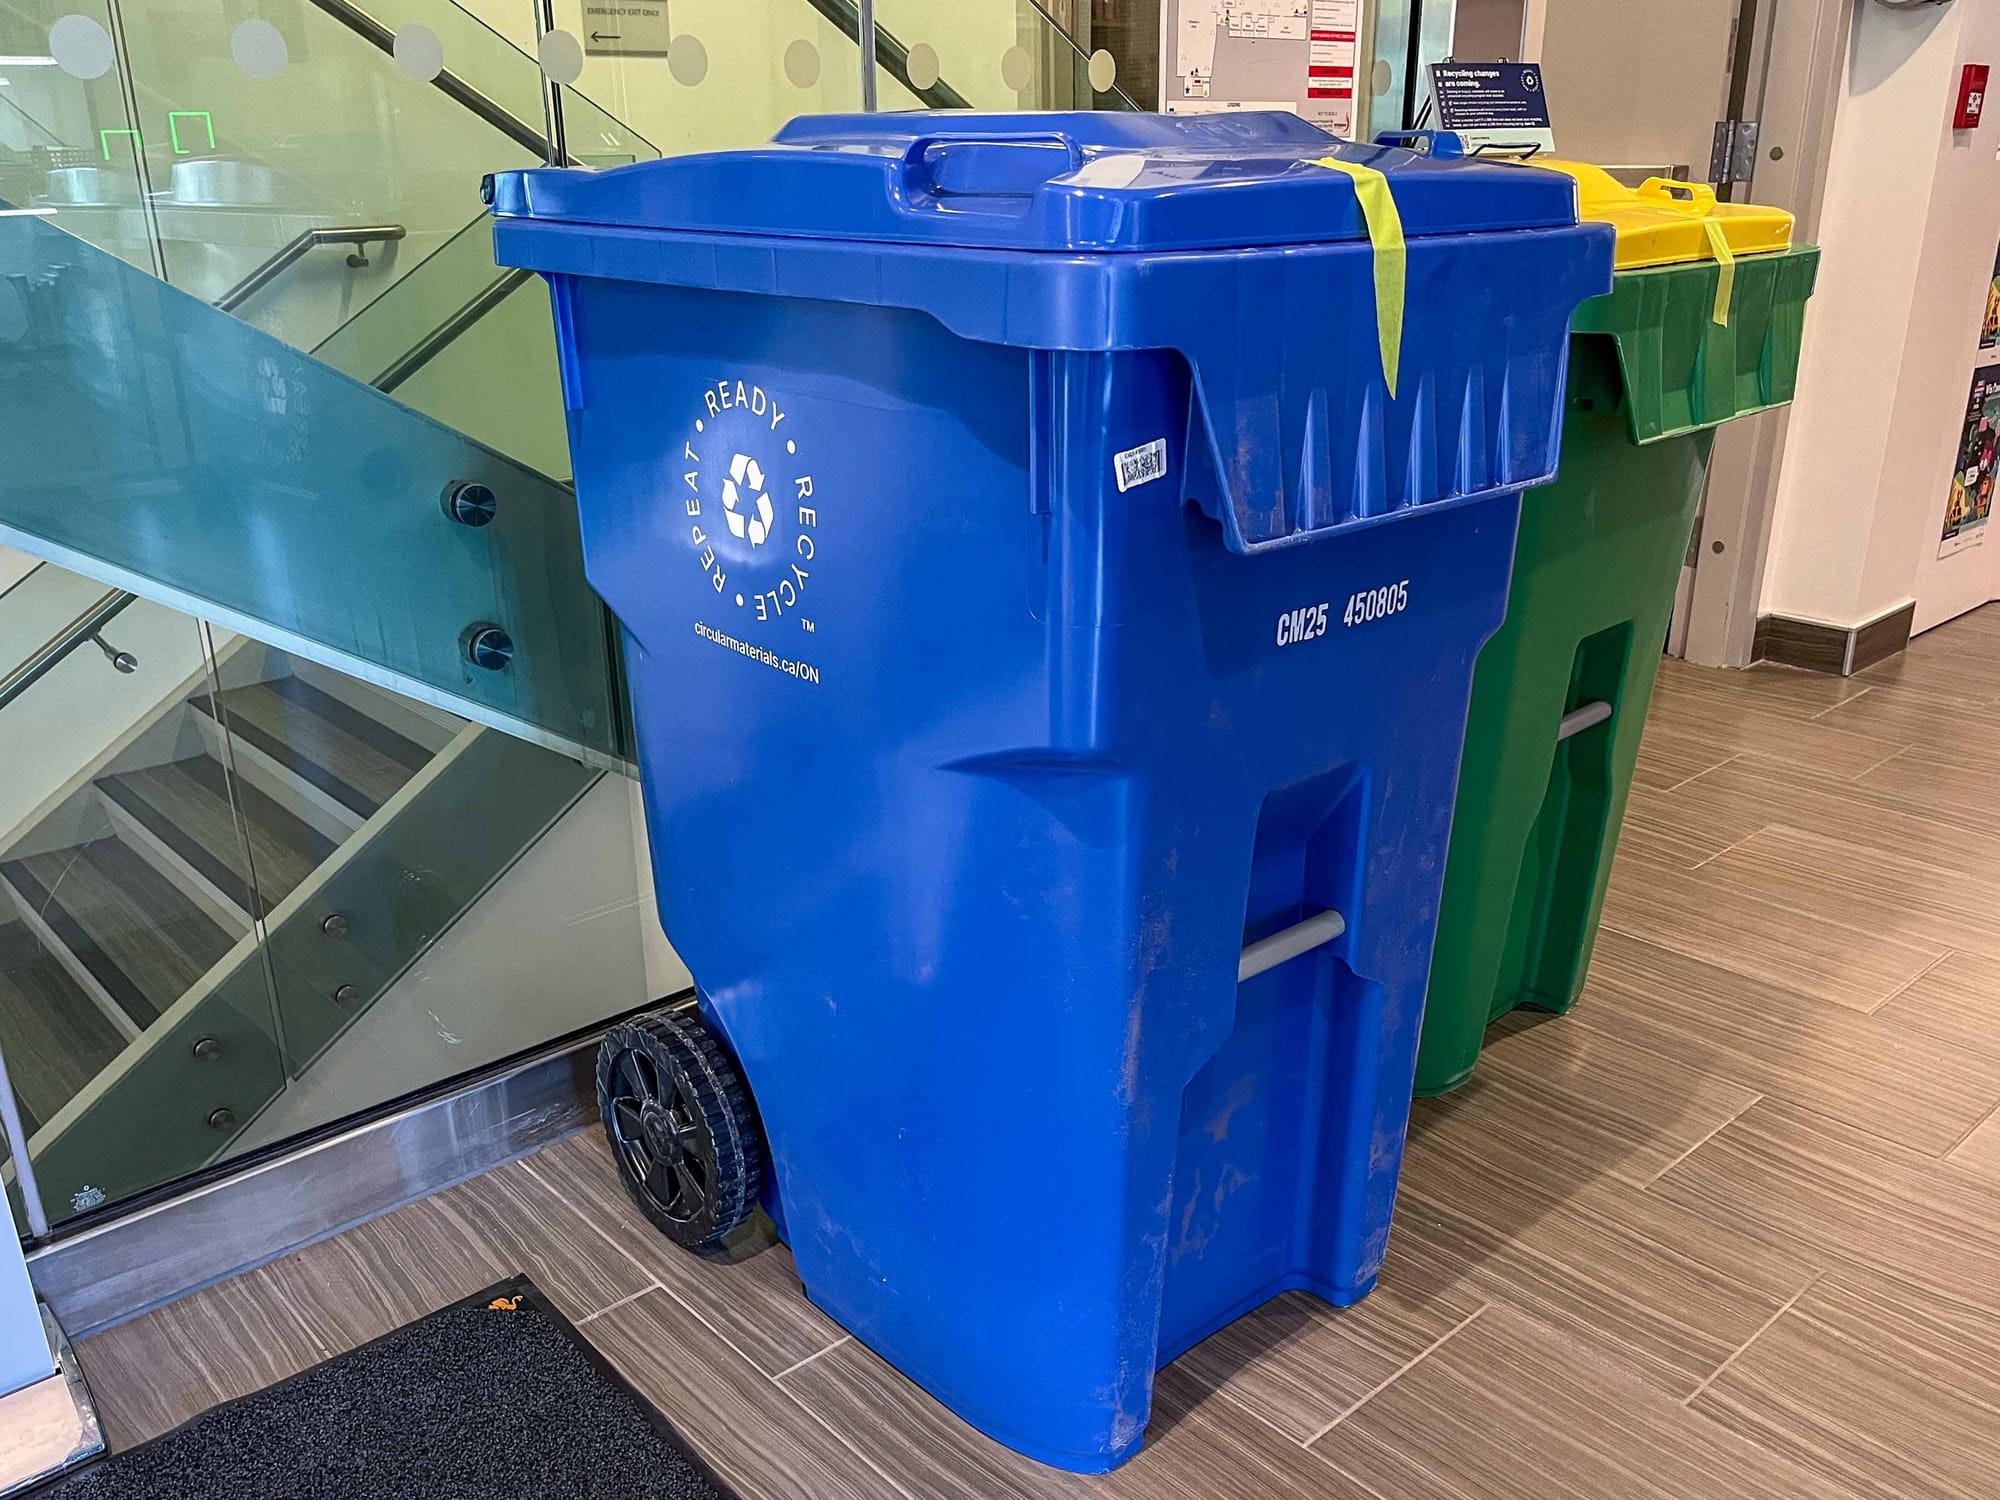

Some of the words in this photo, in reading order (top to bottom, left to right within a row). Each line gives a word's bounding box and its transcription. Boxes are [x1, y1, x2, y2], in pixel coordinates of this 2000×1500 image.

[1442, 69, 1473, 79] Recycling
[1474, 69, 1500, 79] changes
[704, 380, 786, 430] READY
[684, 441, 726, 594] REPEAT
[754, 476, 816, 621] RECYCLE
[1276, 602, 1329, 646] CM25
[1343, 580, 1409, 627] 450805
[694, 620, 820, 685] circularmaterials.ca/ON
